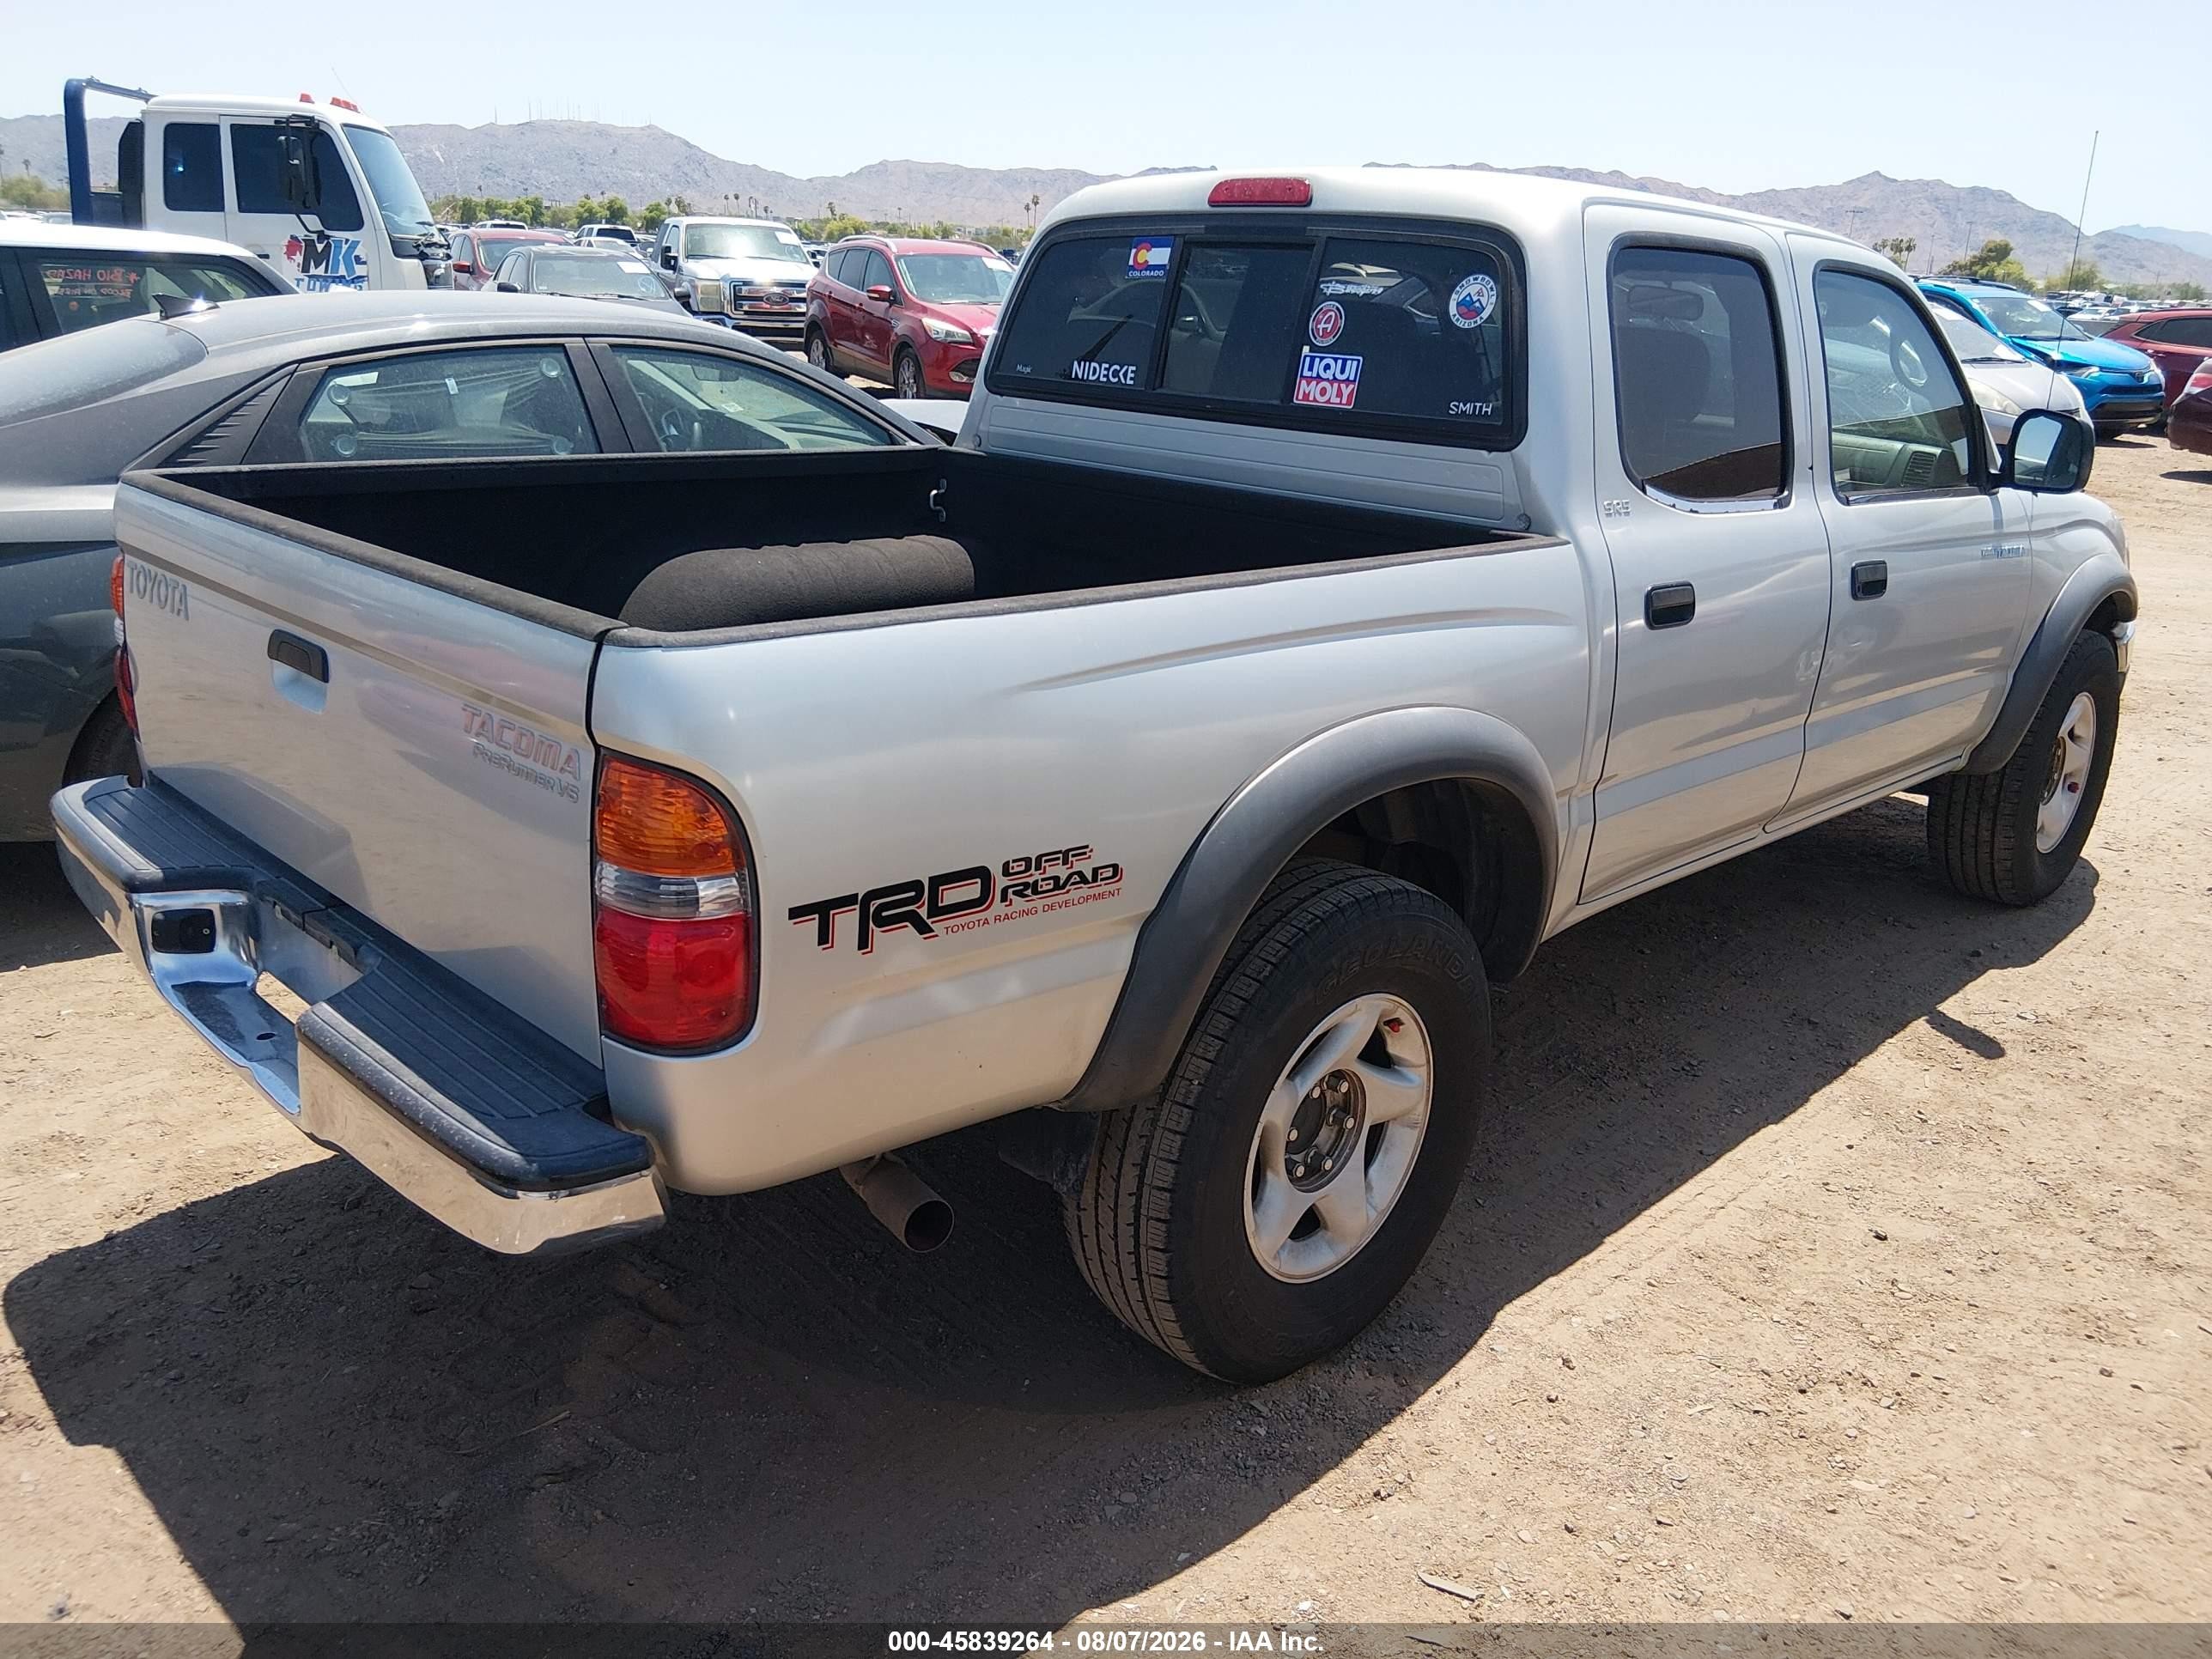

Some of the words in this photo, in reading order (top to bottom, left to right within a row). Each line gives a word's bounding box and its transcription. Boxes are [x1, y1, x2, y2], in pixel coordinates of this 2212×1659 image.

[301, 239, 362, 278] MK
[1455, 276, 1495, 299] SNOWBOWL
[1452, 313, 1484, 327] ARIZONA
[1303, 356, 1358, 380] LIQUI
[1297, 380, 1355, 404] MOLY
[1449, 401, 1492, 416] SMITH
[127, 561, 190, 621] TOYOTA
[461, 703, 581, 781] TACOMA
[1001, 844, 1093, 882] OFF
[1000, 863, 1123, 907] ROAD
[788, 866, 996, 955] TRD
[944, 918, 990, 935] TOYOTA
[994, 906, 1038, 923] RACING
[1042, 887, 1122, 913] DEVELOPMENT
